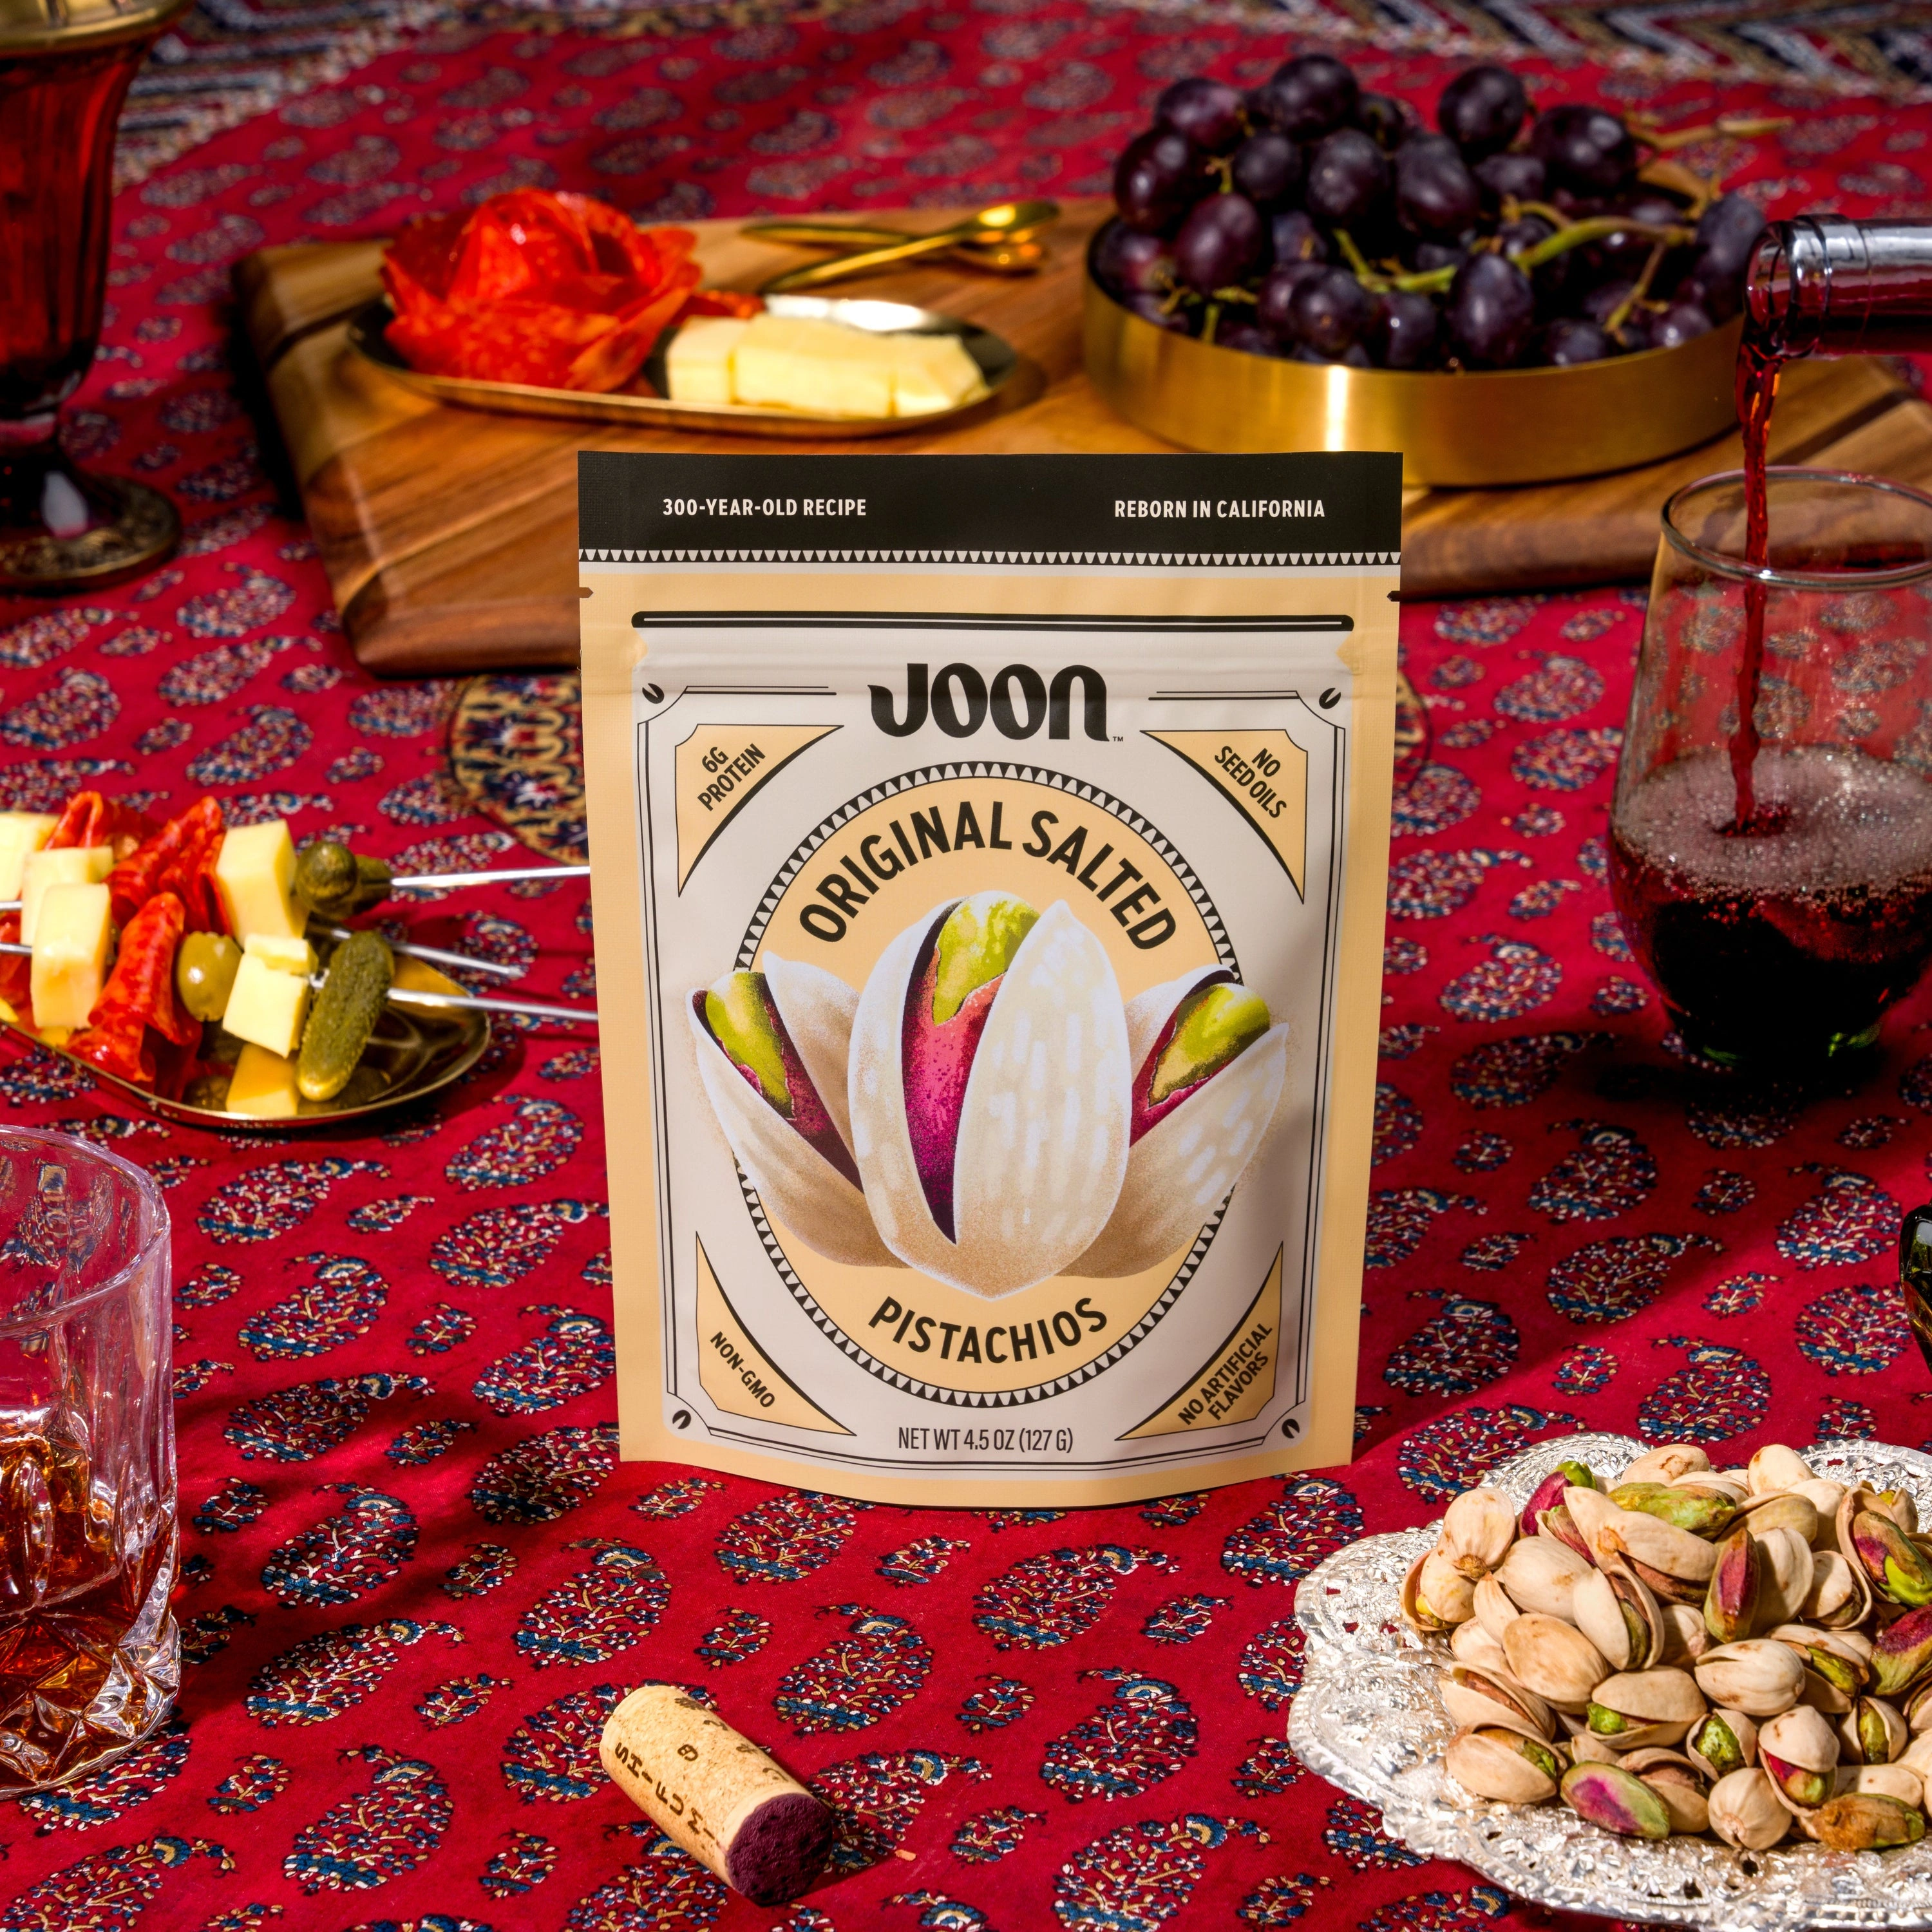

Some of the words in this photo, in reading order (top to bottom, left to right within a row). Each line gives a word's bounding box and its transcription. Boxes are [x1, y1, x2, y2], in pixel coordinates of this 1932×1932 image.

[663, 498, 797, 516] 300-YEAR-OLD
[803, 498, 866, 516] RECIPE
[1115, 500, 1186, 518] REBORN
[1193, 500, 1211, 518] IN
[1217, 500, 1325, 518] CALIFORNIA
[697, 743, 766, 811] PROTEIN
[702, 746, 729, 773] 6G
[1215, 746, 1256, 787] SEED
[1249, 781, 1287, 819] OILS
[1251, 748, 1281, 777] NO
[799, 806, 1012, 943] ORIGINAL
[1022, 810, 1176, 950] SALTED
[868, 1296, 1107, 1364] PISTACHIOS
[710, 1331, 775, 1408] NON-GMO
[1178, 1399, 1204, 1425] NO
[1200, 1323, 1273, 1404] ARTIFICIAL
[1208, 1351, 1269, 1421] FLAVORS
[898, 1426, 930, 1450] NET
[934, 1428, 960, 1450] WT
[963, 1429, 989, 1450] 4.5
[994, 1429, 1015, 1450] OZ
[1019, 1428, 1053, 1453] (127
[1056, 1427, 1074, 1454] G)
